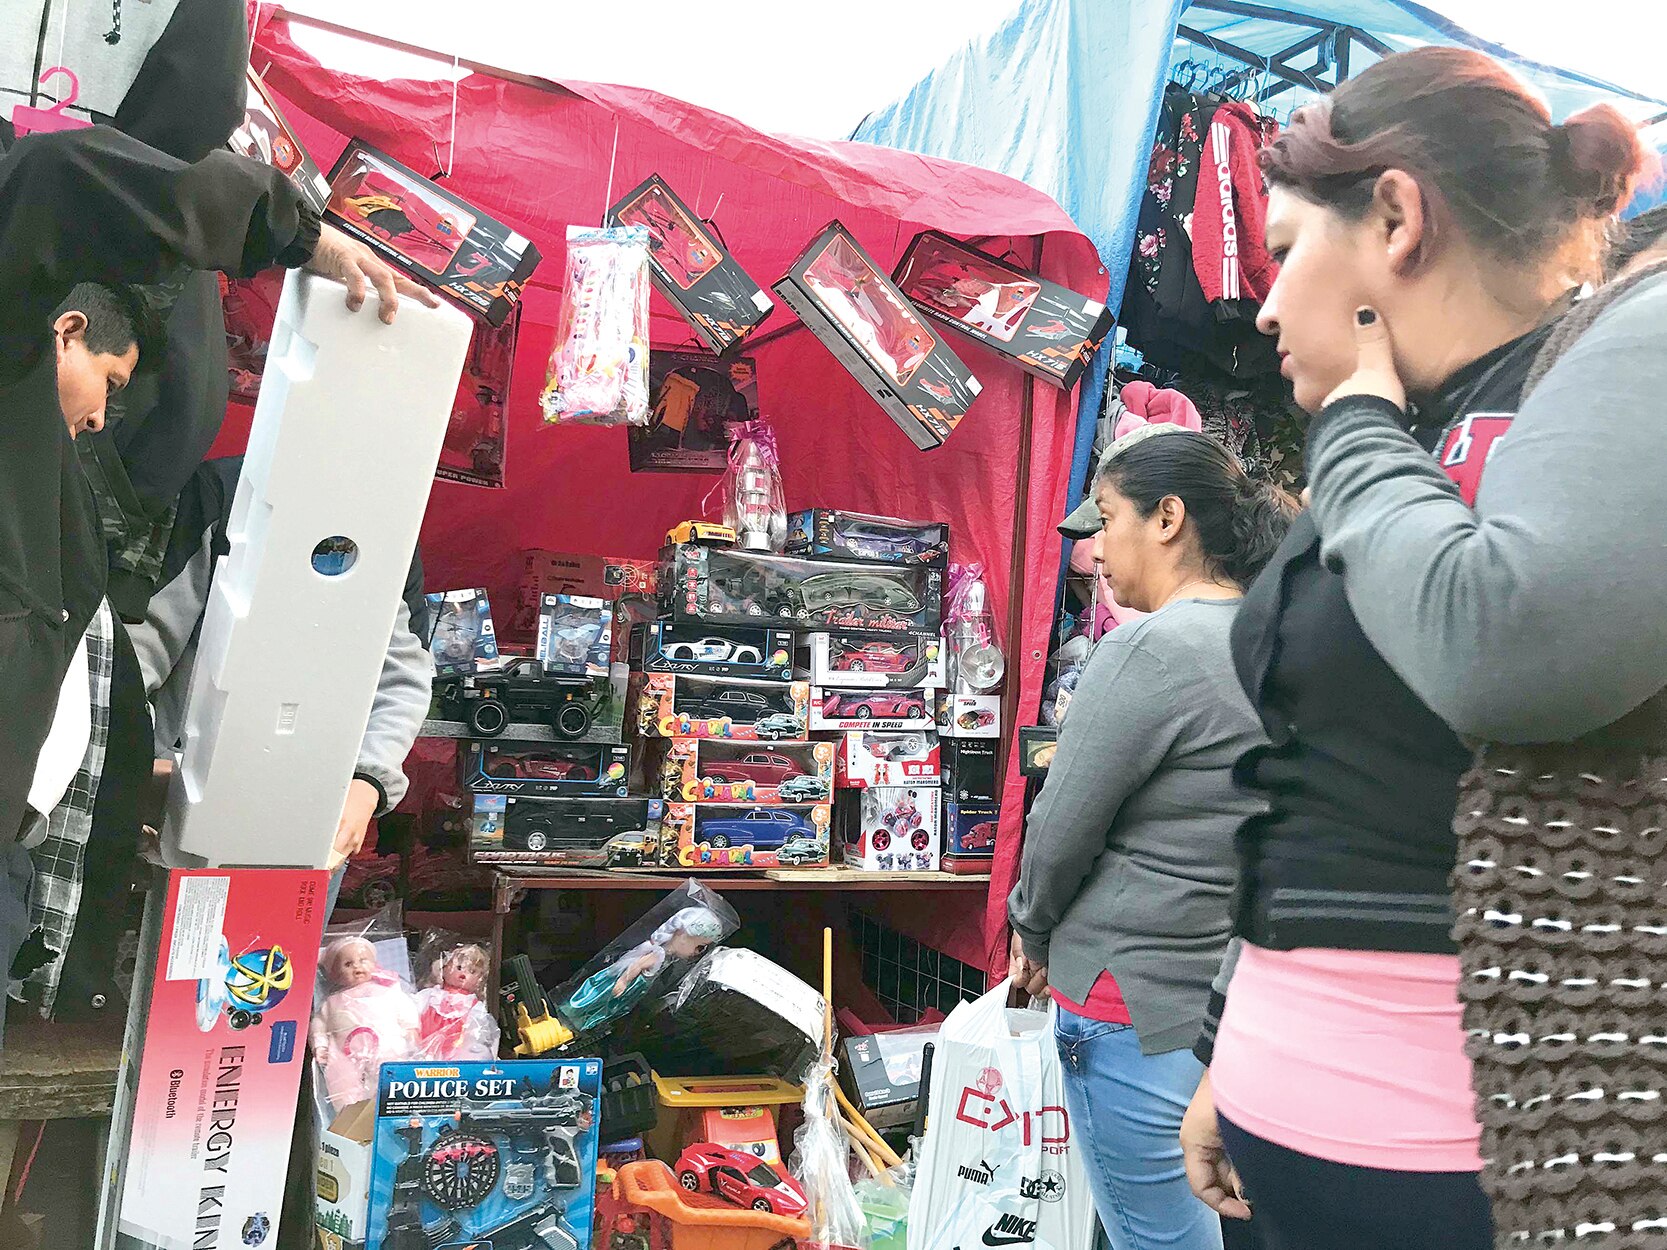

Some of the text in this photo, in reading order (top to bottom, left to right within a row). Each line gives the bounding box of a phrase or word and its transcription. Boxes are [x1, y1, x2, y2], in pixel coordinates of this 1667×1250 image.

[1217, 161, 1238, 257] adidas
[436, 469, 459, 479] UPER
[838, 721, 904, 729] COMPETE IN SPEED
[682, 780, 757, 801] CARNAVAL
[679, 844, 754, 867] CARNAVAL
[415, 1068, 460, 1077] WARRIOR
[165, 1080, 181, 1119] Bluetooth
[388, 1080, 517, 1099] POLICE SET
[204, 1045, 246, 1173] ENERGY
[1042, 1146, 1070, 1156] PORT
[958, 1165, 990, 1186] PUMA
[994, 1213, 1037, 1240] NIKE
